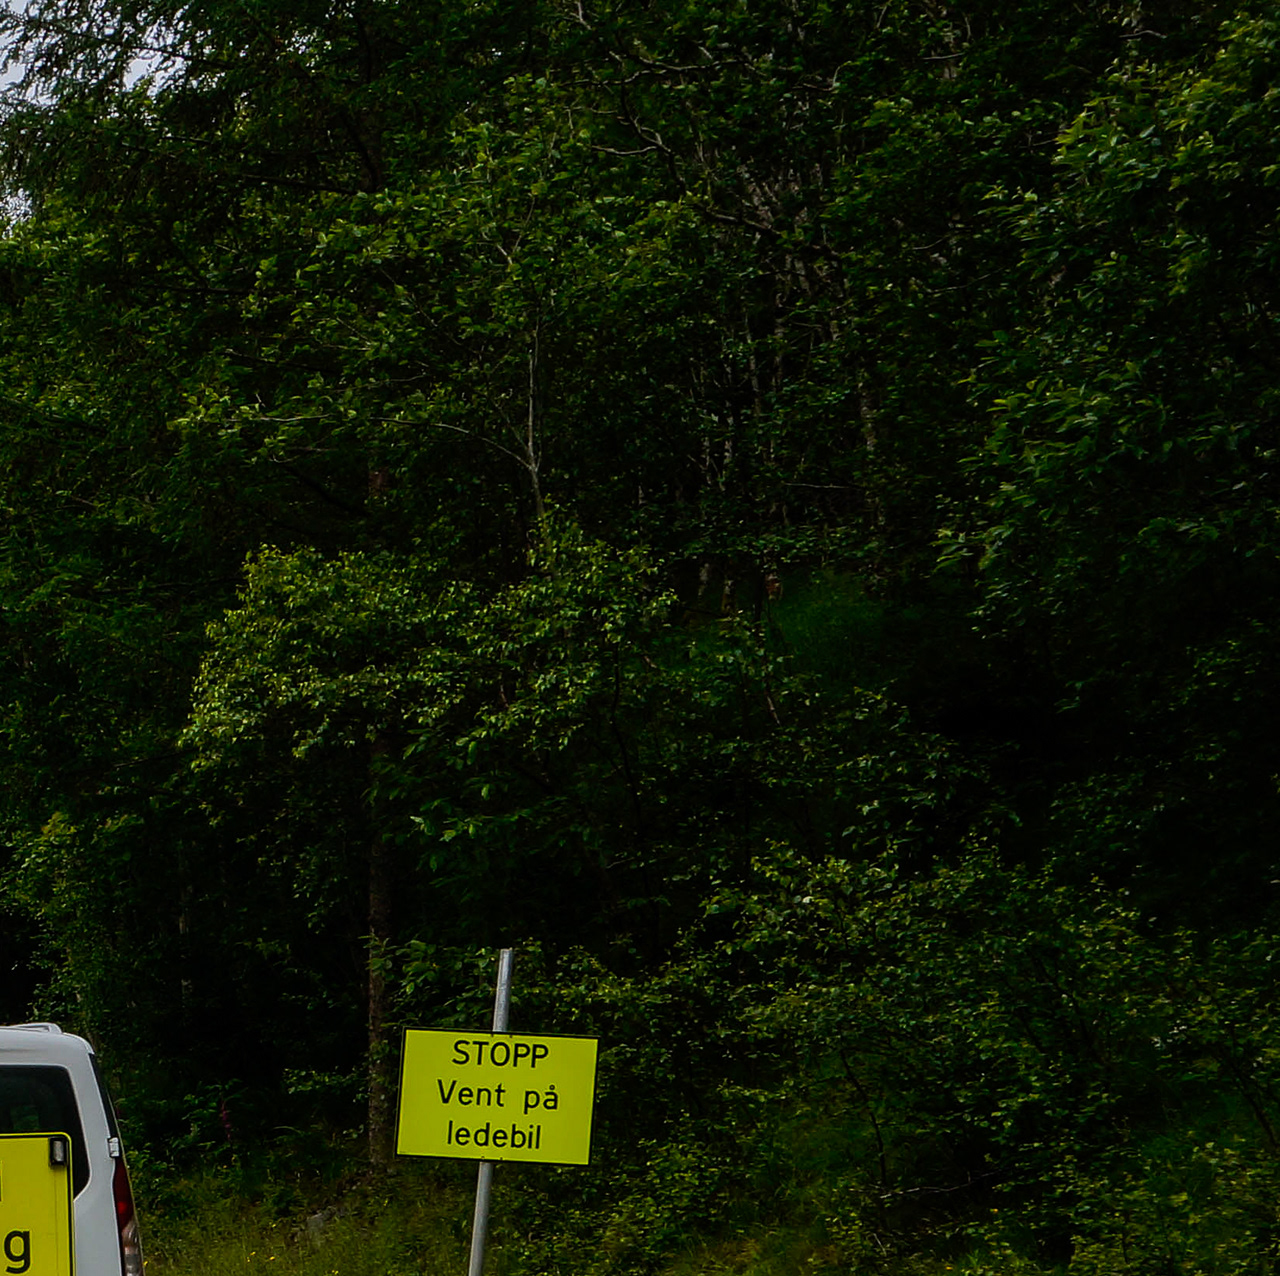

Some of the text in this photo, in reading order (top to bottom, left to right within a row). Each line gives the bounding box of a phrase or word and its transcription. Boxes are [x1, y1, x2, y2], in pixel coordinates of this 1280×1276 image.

[451, 1040, 549, 1069] STOPP
[437, 1079, 558, 1115] Vent på
[447, 1120, 542, 1150] ledebil
